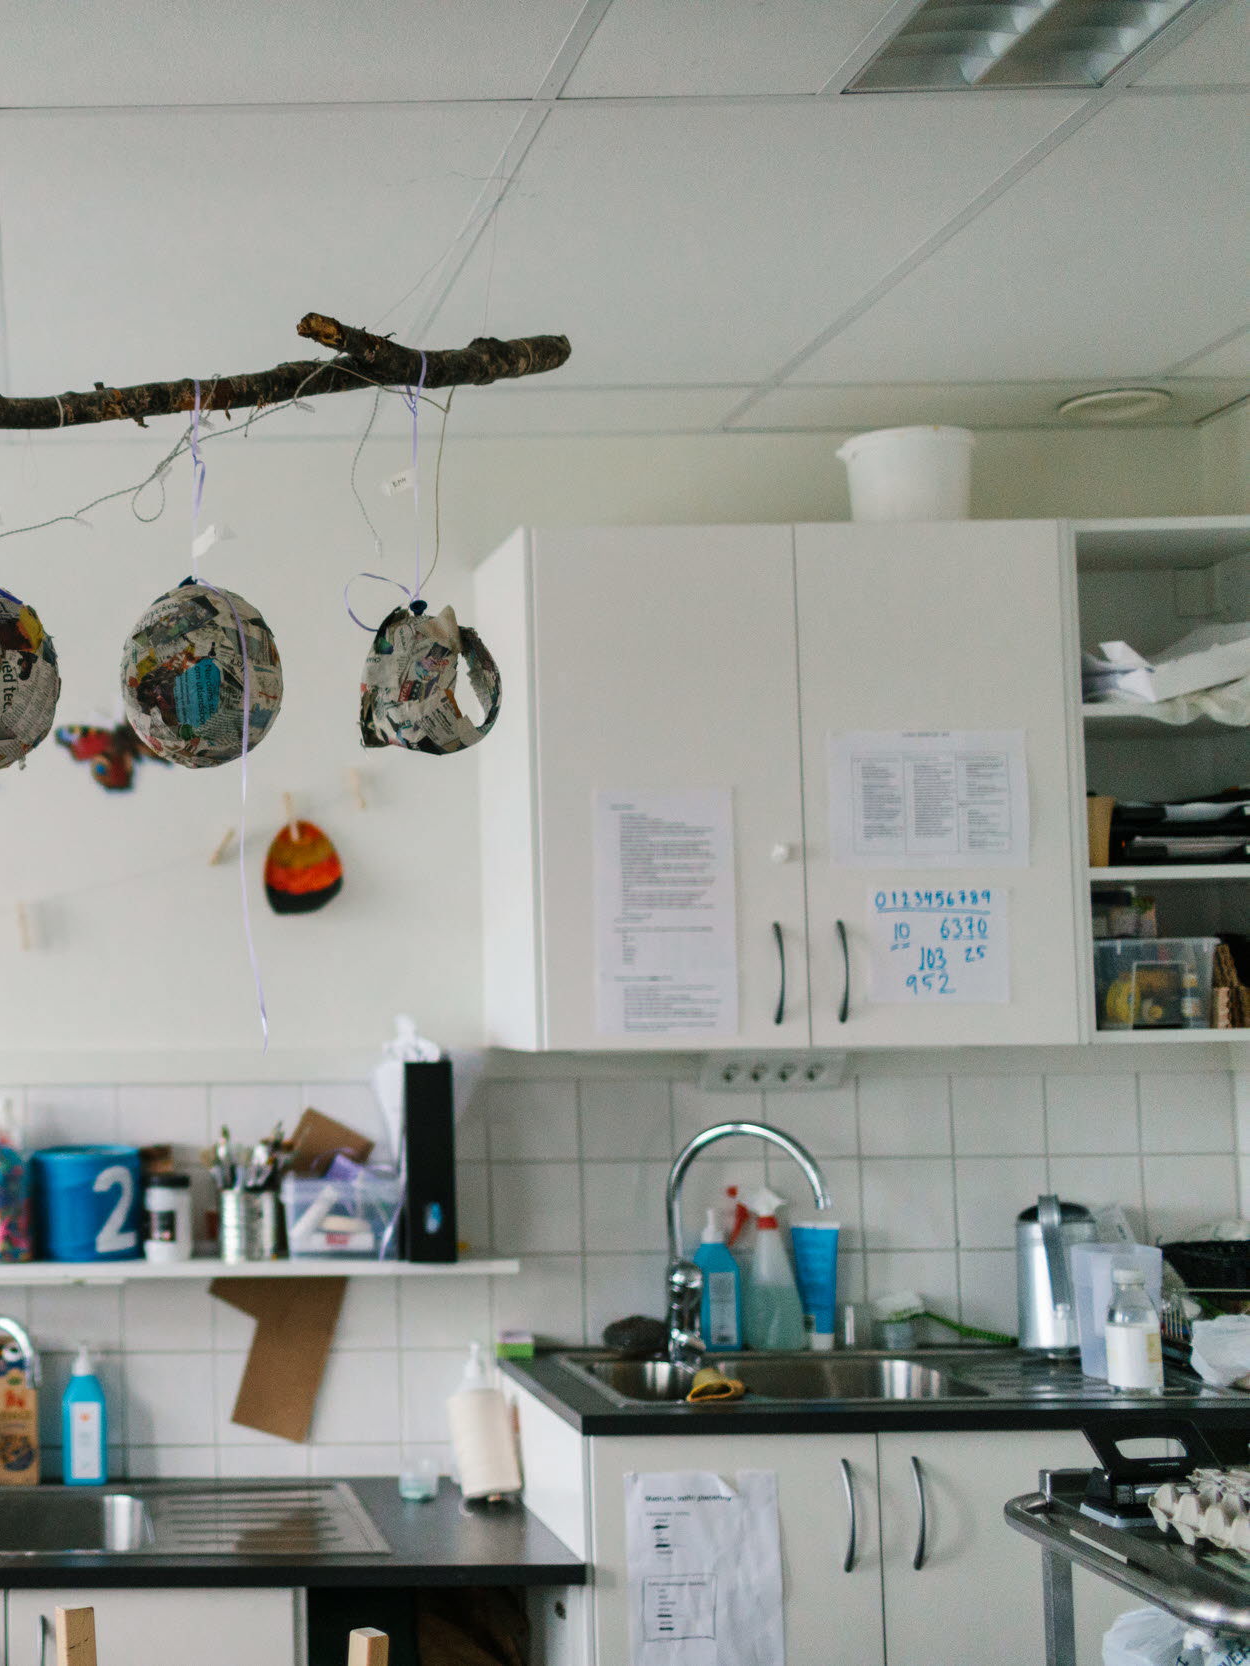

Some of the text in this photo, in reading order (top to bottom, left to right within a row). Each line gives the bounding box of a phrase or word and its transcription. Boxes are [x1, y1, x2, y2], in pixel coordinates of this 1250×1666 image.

[893, 921, 911, 941] 10
[918, 944, 987, 971] 103 25
[905, 972, 957, 995] 952
[93, 1166, 137, 1253] 2
